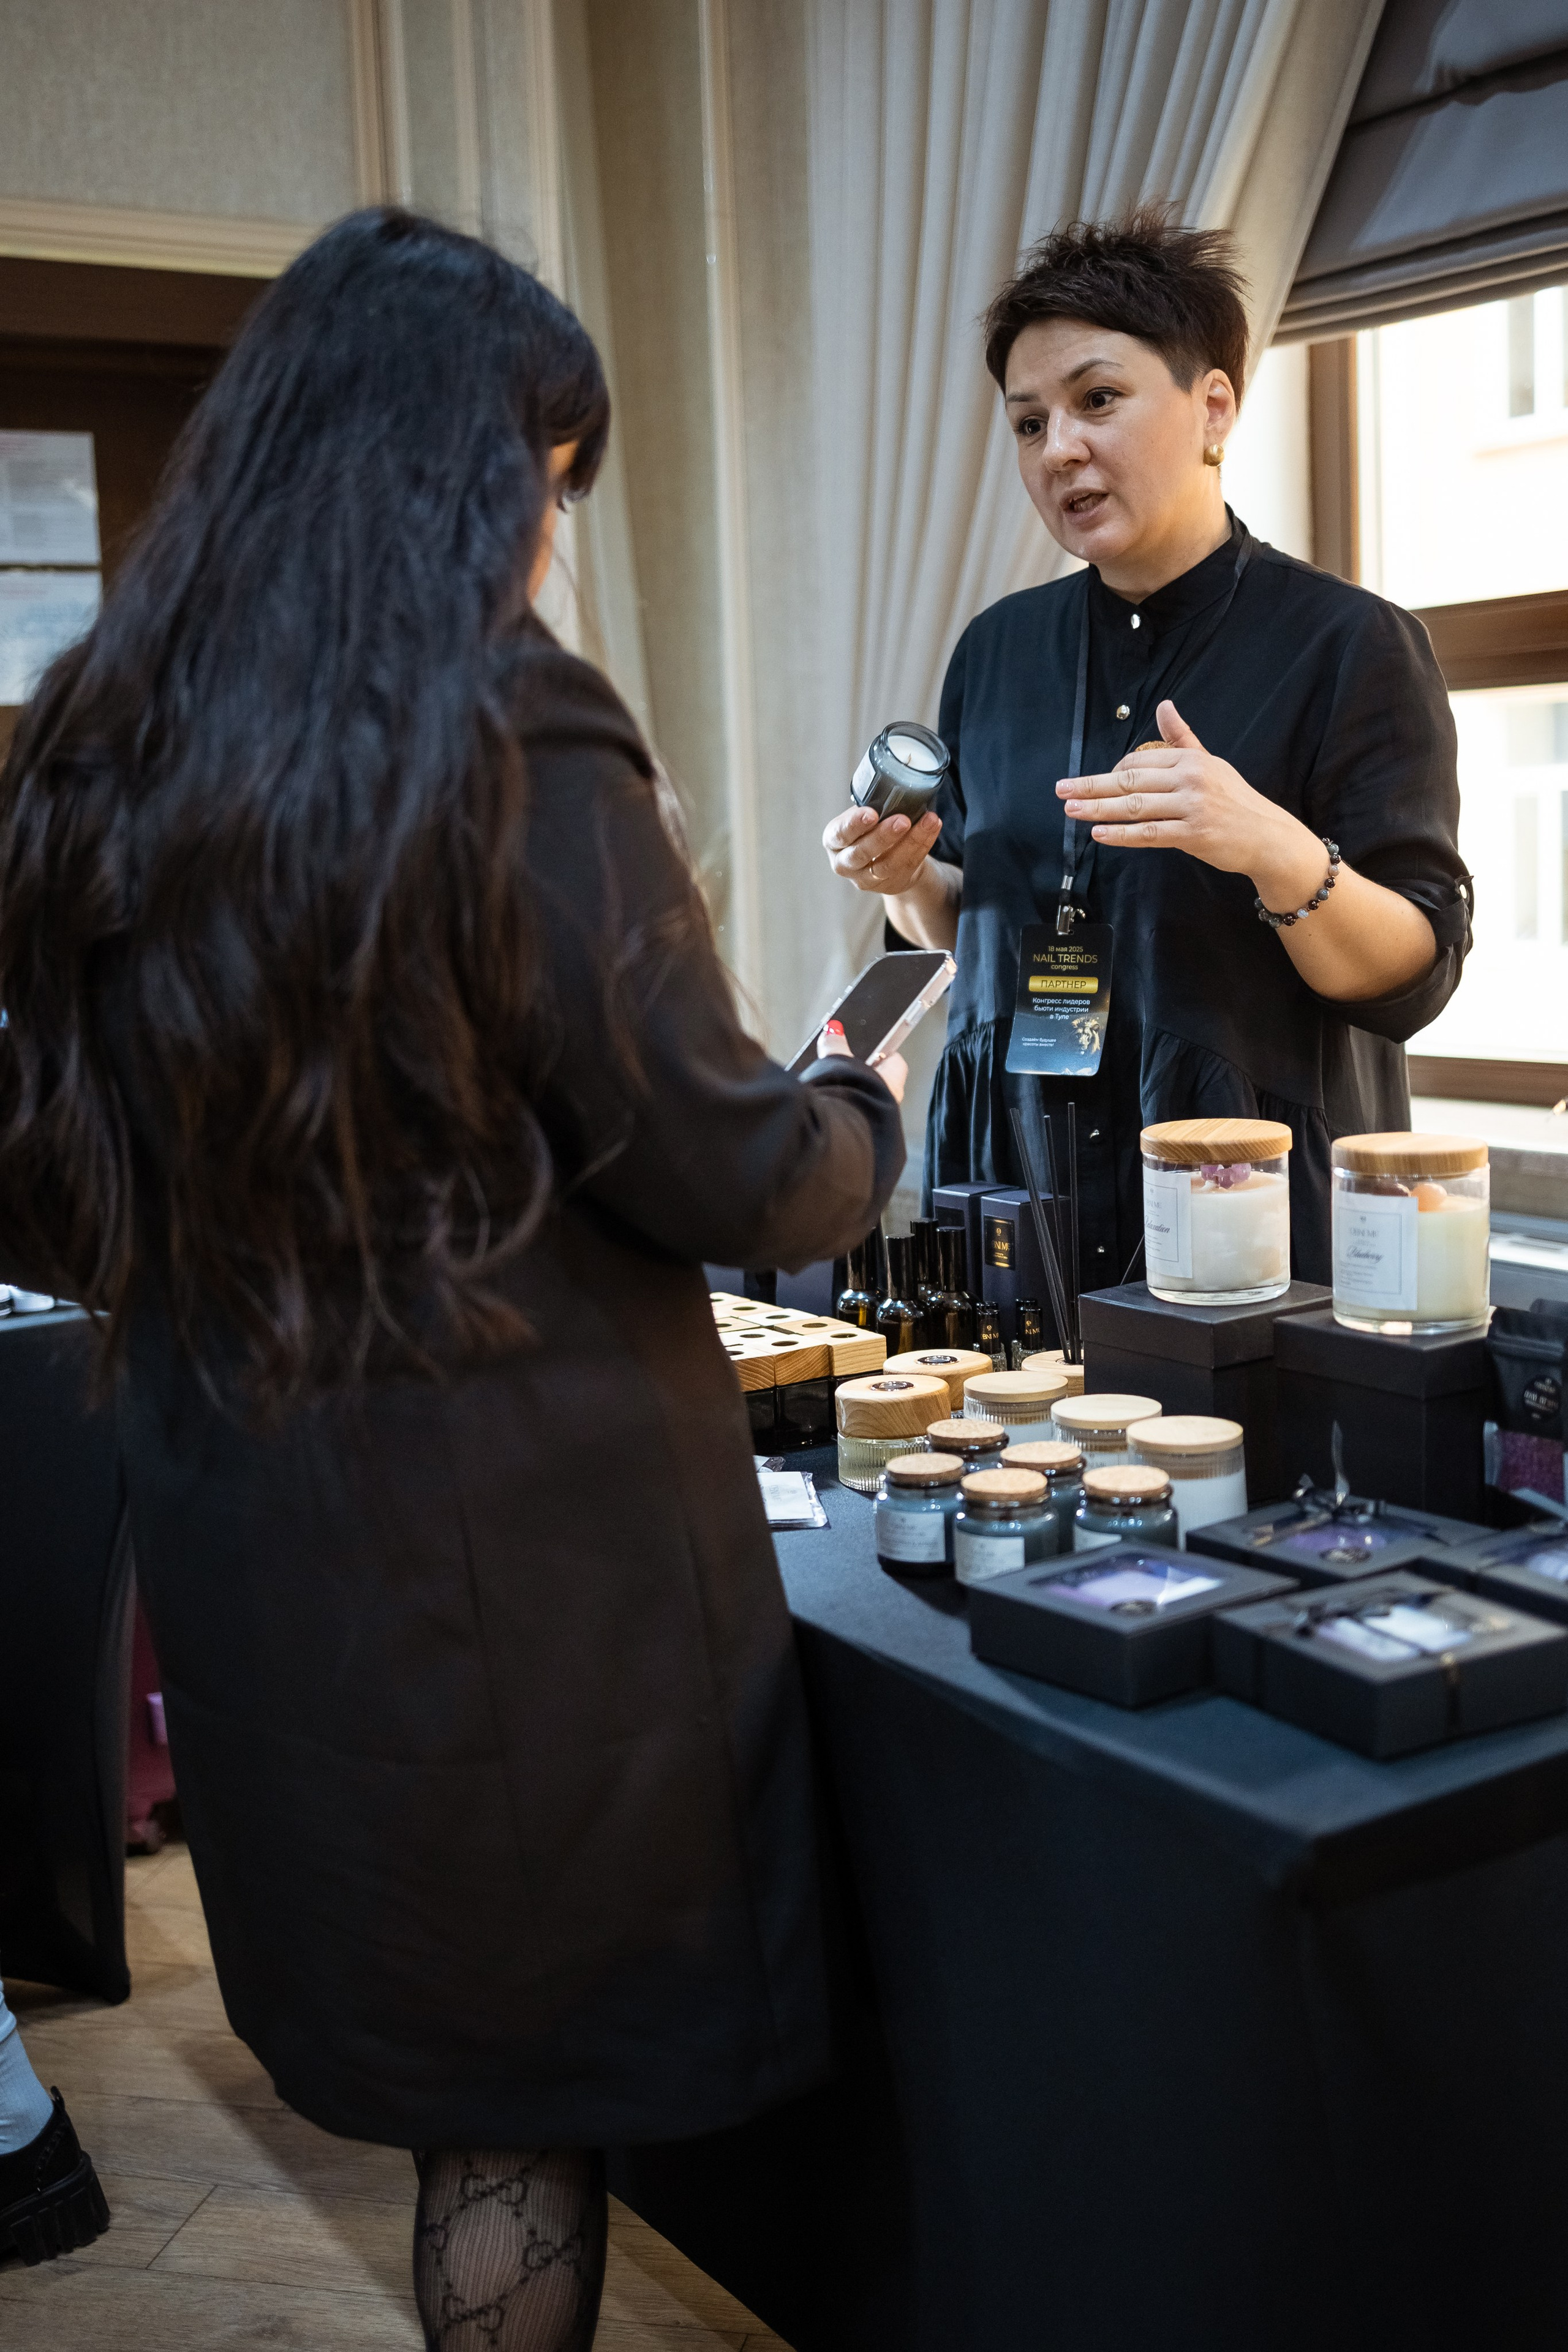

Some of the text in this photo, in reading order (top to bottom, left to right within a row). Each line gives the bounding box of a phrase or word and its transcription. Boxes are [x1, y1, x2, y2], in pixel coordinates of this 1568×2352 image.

[1033, 954, 1098, 963] NAIL TRENDS
[1041, 980, 1087, 989] ПАРТНЕР
